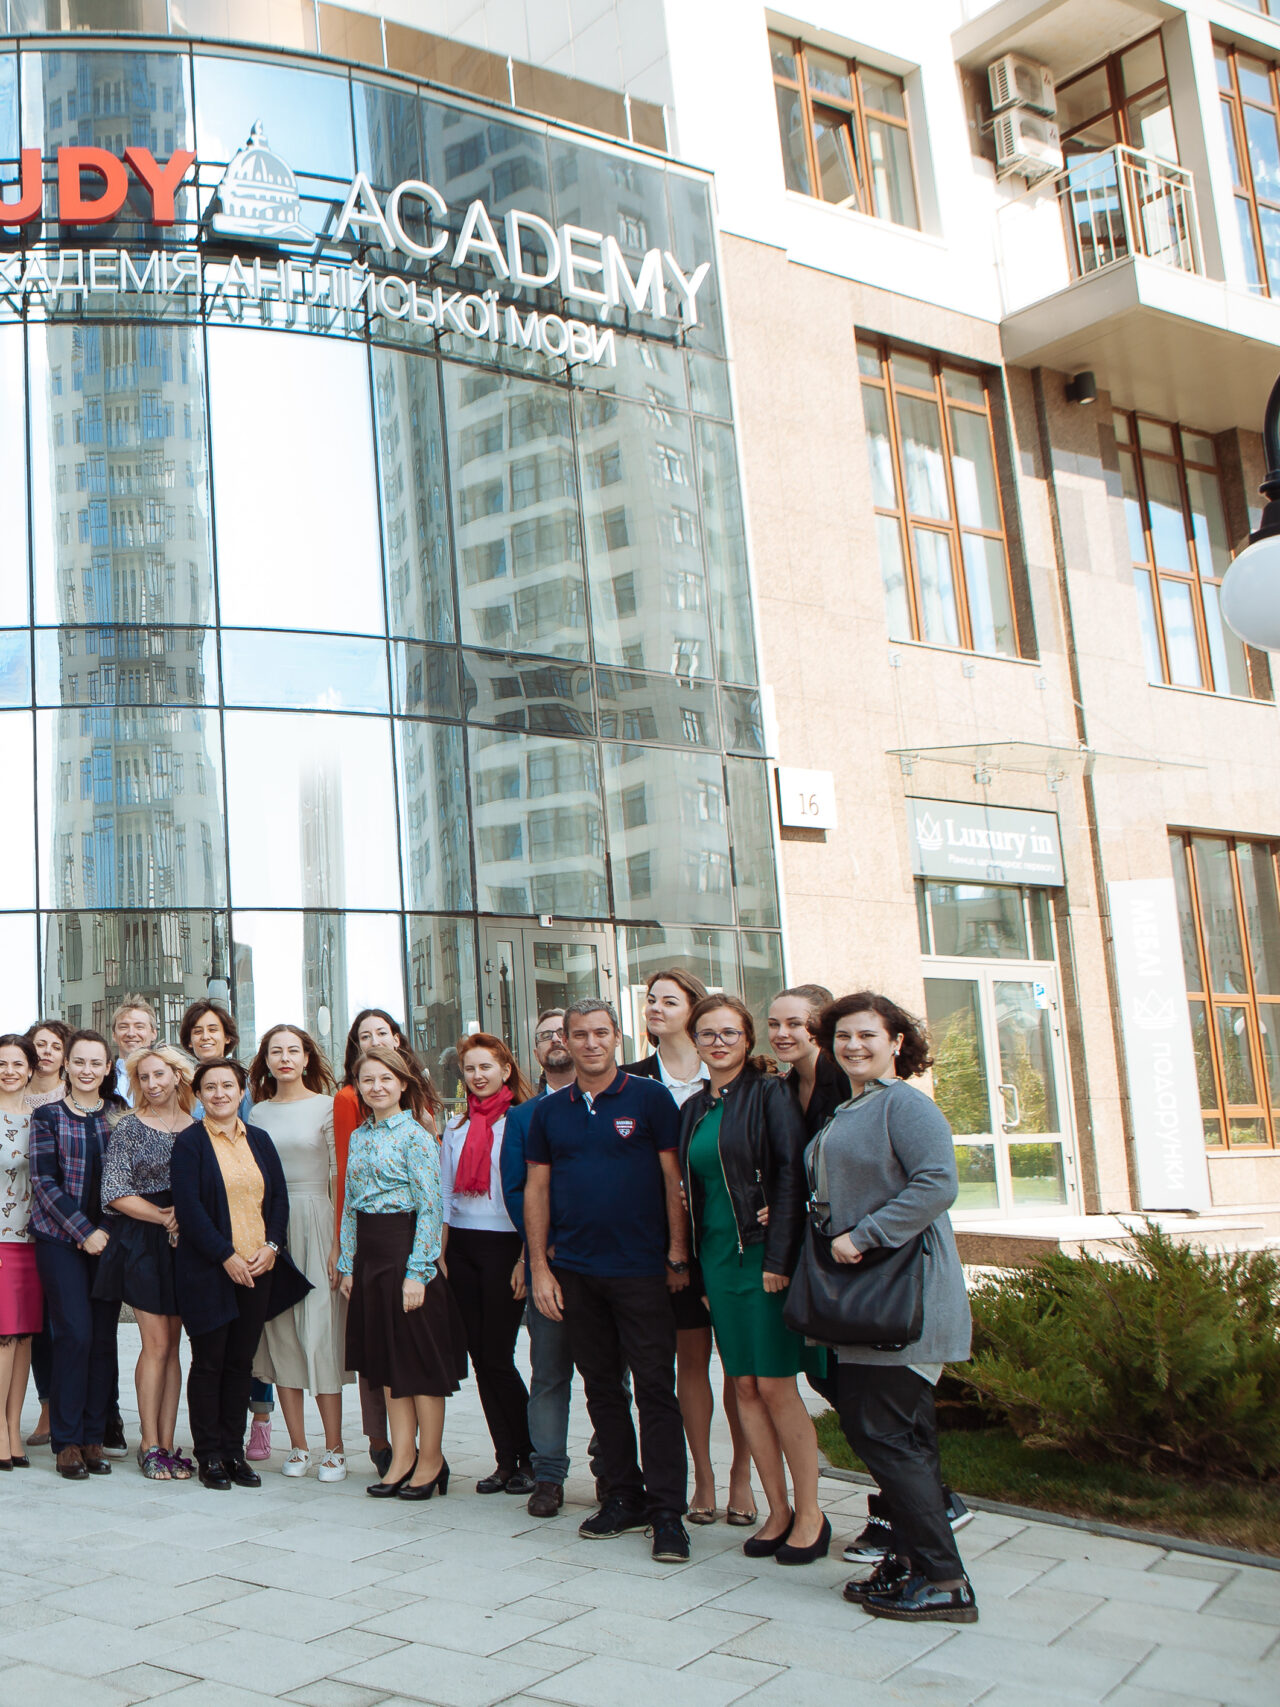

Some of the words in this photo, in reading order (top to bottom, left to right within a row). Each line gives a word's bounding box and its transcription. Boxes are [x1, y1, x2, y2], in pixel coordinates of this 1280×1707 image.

[331, 172, 711, 328] ACADEMY
[220, 254, 500, 342] АНГЛІЙСЬКОЇ
[505, 304, 617, 368] МОВИ
[799, 793, 819, 816] 16
[944, 818, 1027, 859] Luxury
[1030, 824, 1054, 855] in
[1130, 898, 1163, 977] МЕБЛІ
